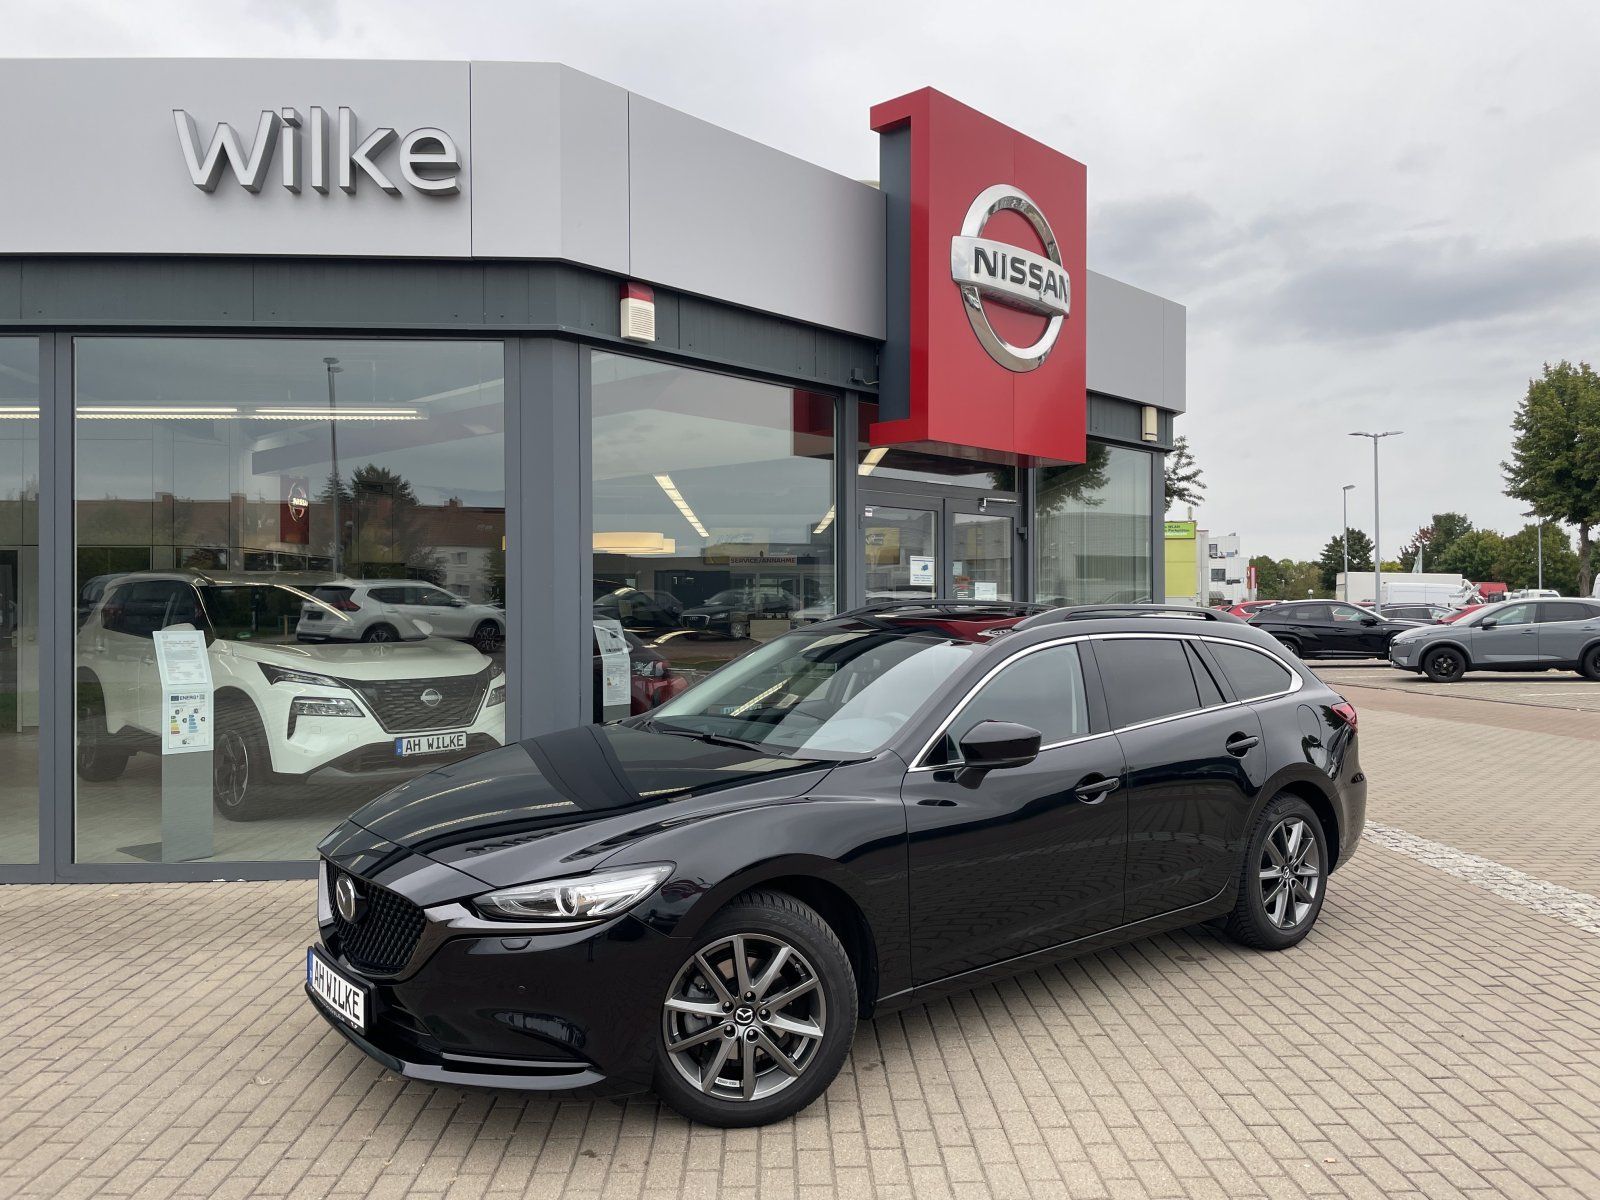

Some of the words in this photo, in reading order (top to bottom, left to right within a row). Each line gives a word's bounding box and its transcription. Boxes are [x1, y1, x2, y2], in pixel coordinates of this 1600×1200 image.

[172, 105, 462, 196] Wilke
[974, 246, 1069, 304] NISSAN
[405, 739, 421, 753] AH
[427, 734, 464, 751] WILKE
[313, 960, 325, 993] AH
[326, 970, 361, 1022] WILKE
